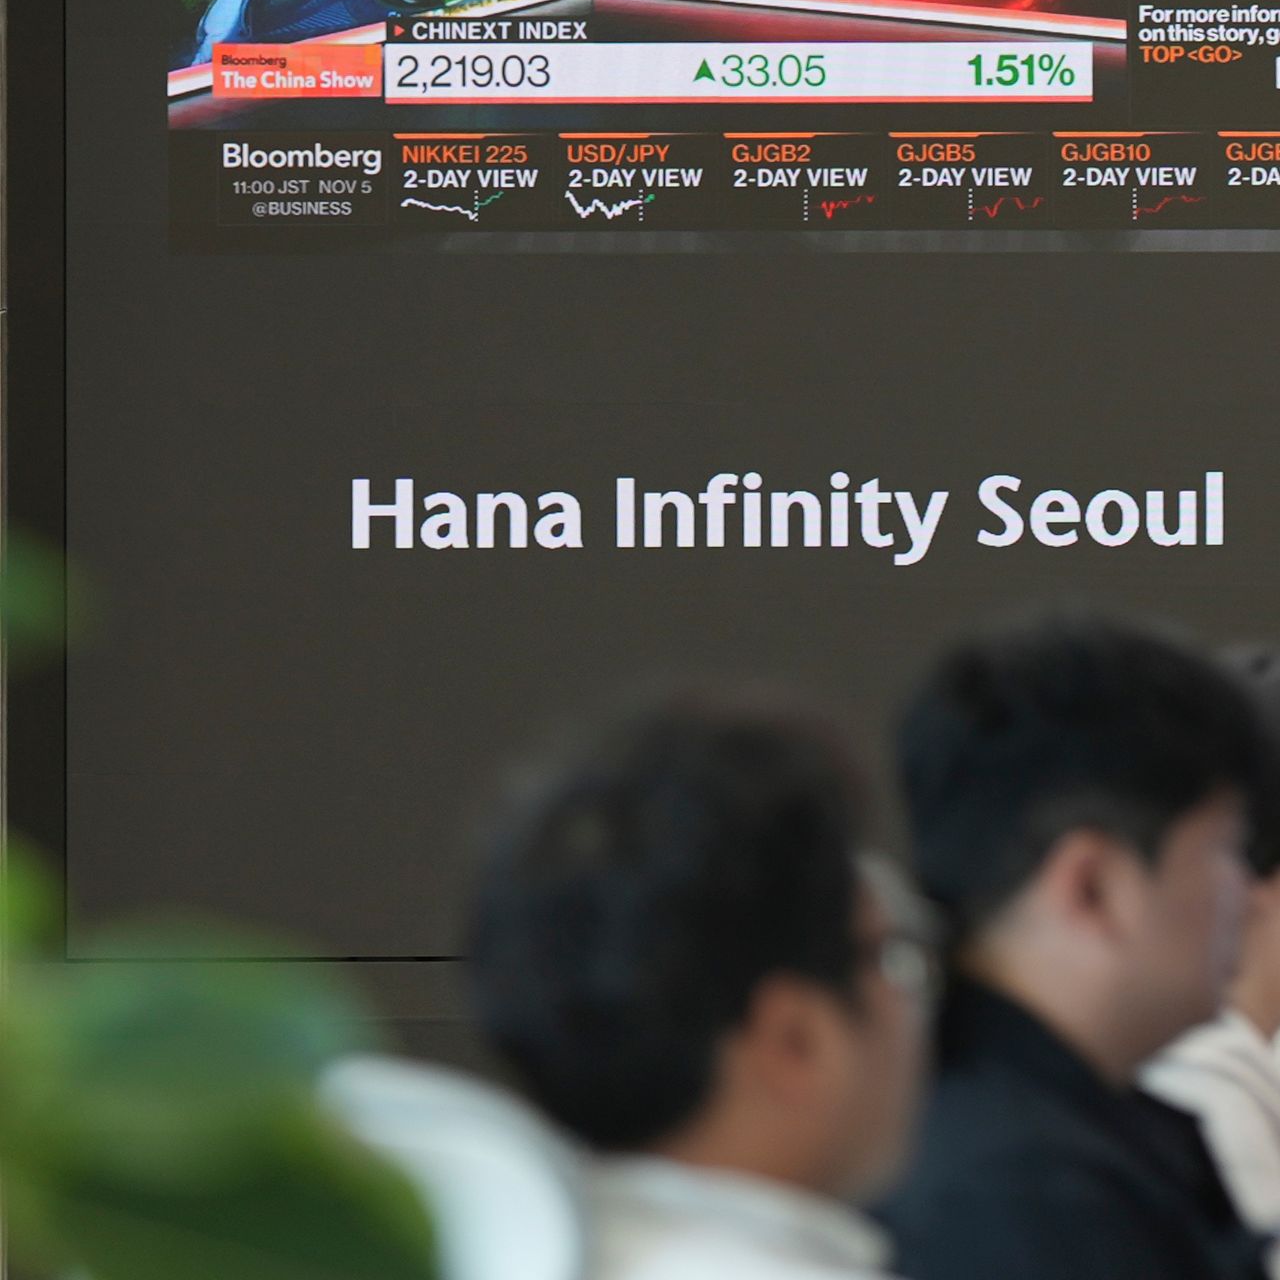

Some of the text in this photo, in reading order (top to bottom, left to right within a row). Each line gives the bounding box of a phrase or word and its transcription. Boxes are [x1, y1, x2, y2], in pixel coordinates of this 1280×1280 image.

[411, 21, 588, 41] CHINEXT INDEX
[221, 54, 288, 70] Bloomberg
[221, 70, 374, 89] The China Show
[396, 53, 1076, 94] 2,219.03 33.05 1.51%
[222, 142, 382, 175] Bloomberg
[402, 145, 529, 164] NIKKEI 225
[567, 143, 670, 166] USD/JPY
[730, 142, 813, 164] GJGB2
[896, 143, 976, 162] GJGB5
[1060, 142, 1152, 162] GJGB10
[403, 168, 539, 189] 2-DAY VIEW
[568, 168, 703, 189] 2-DAY VIEW
[733, 167, 868, 188] 2-DAY VIEW
[898, 167, 1033, 187] 2-DAY VIEW
[1062, 166, 1197, 187] 2-DAY VIEW
[232, 179, 373, 195] 11:00 JST NOV 5
[252, 201, 353, 217] @BUSINESS
[351, 471, 1224, 566] Hana Infinity Seoul
